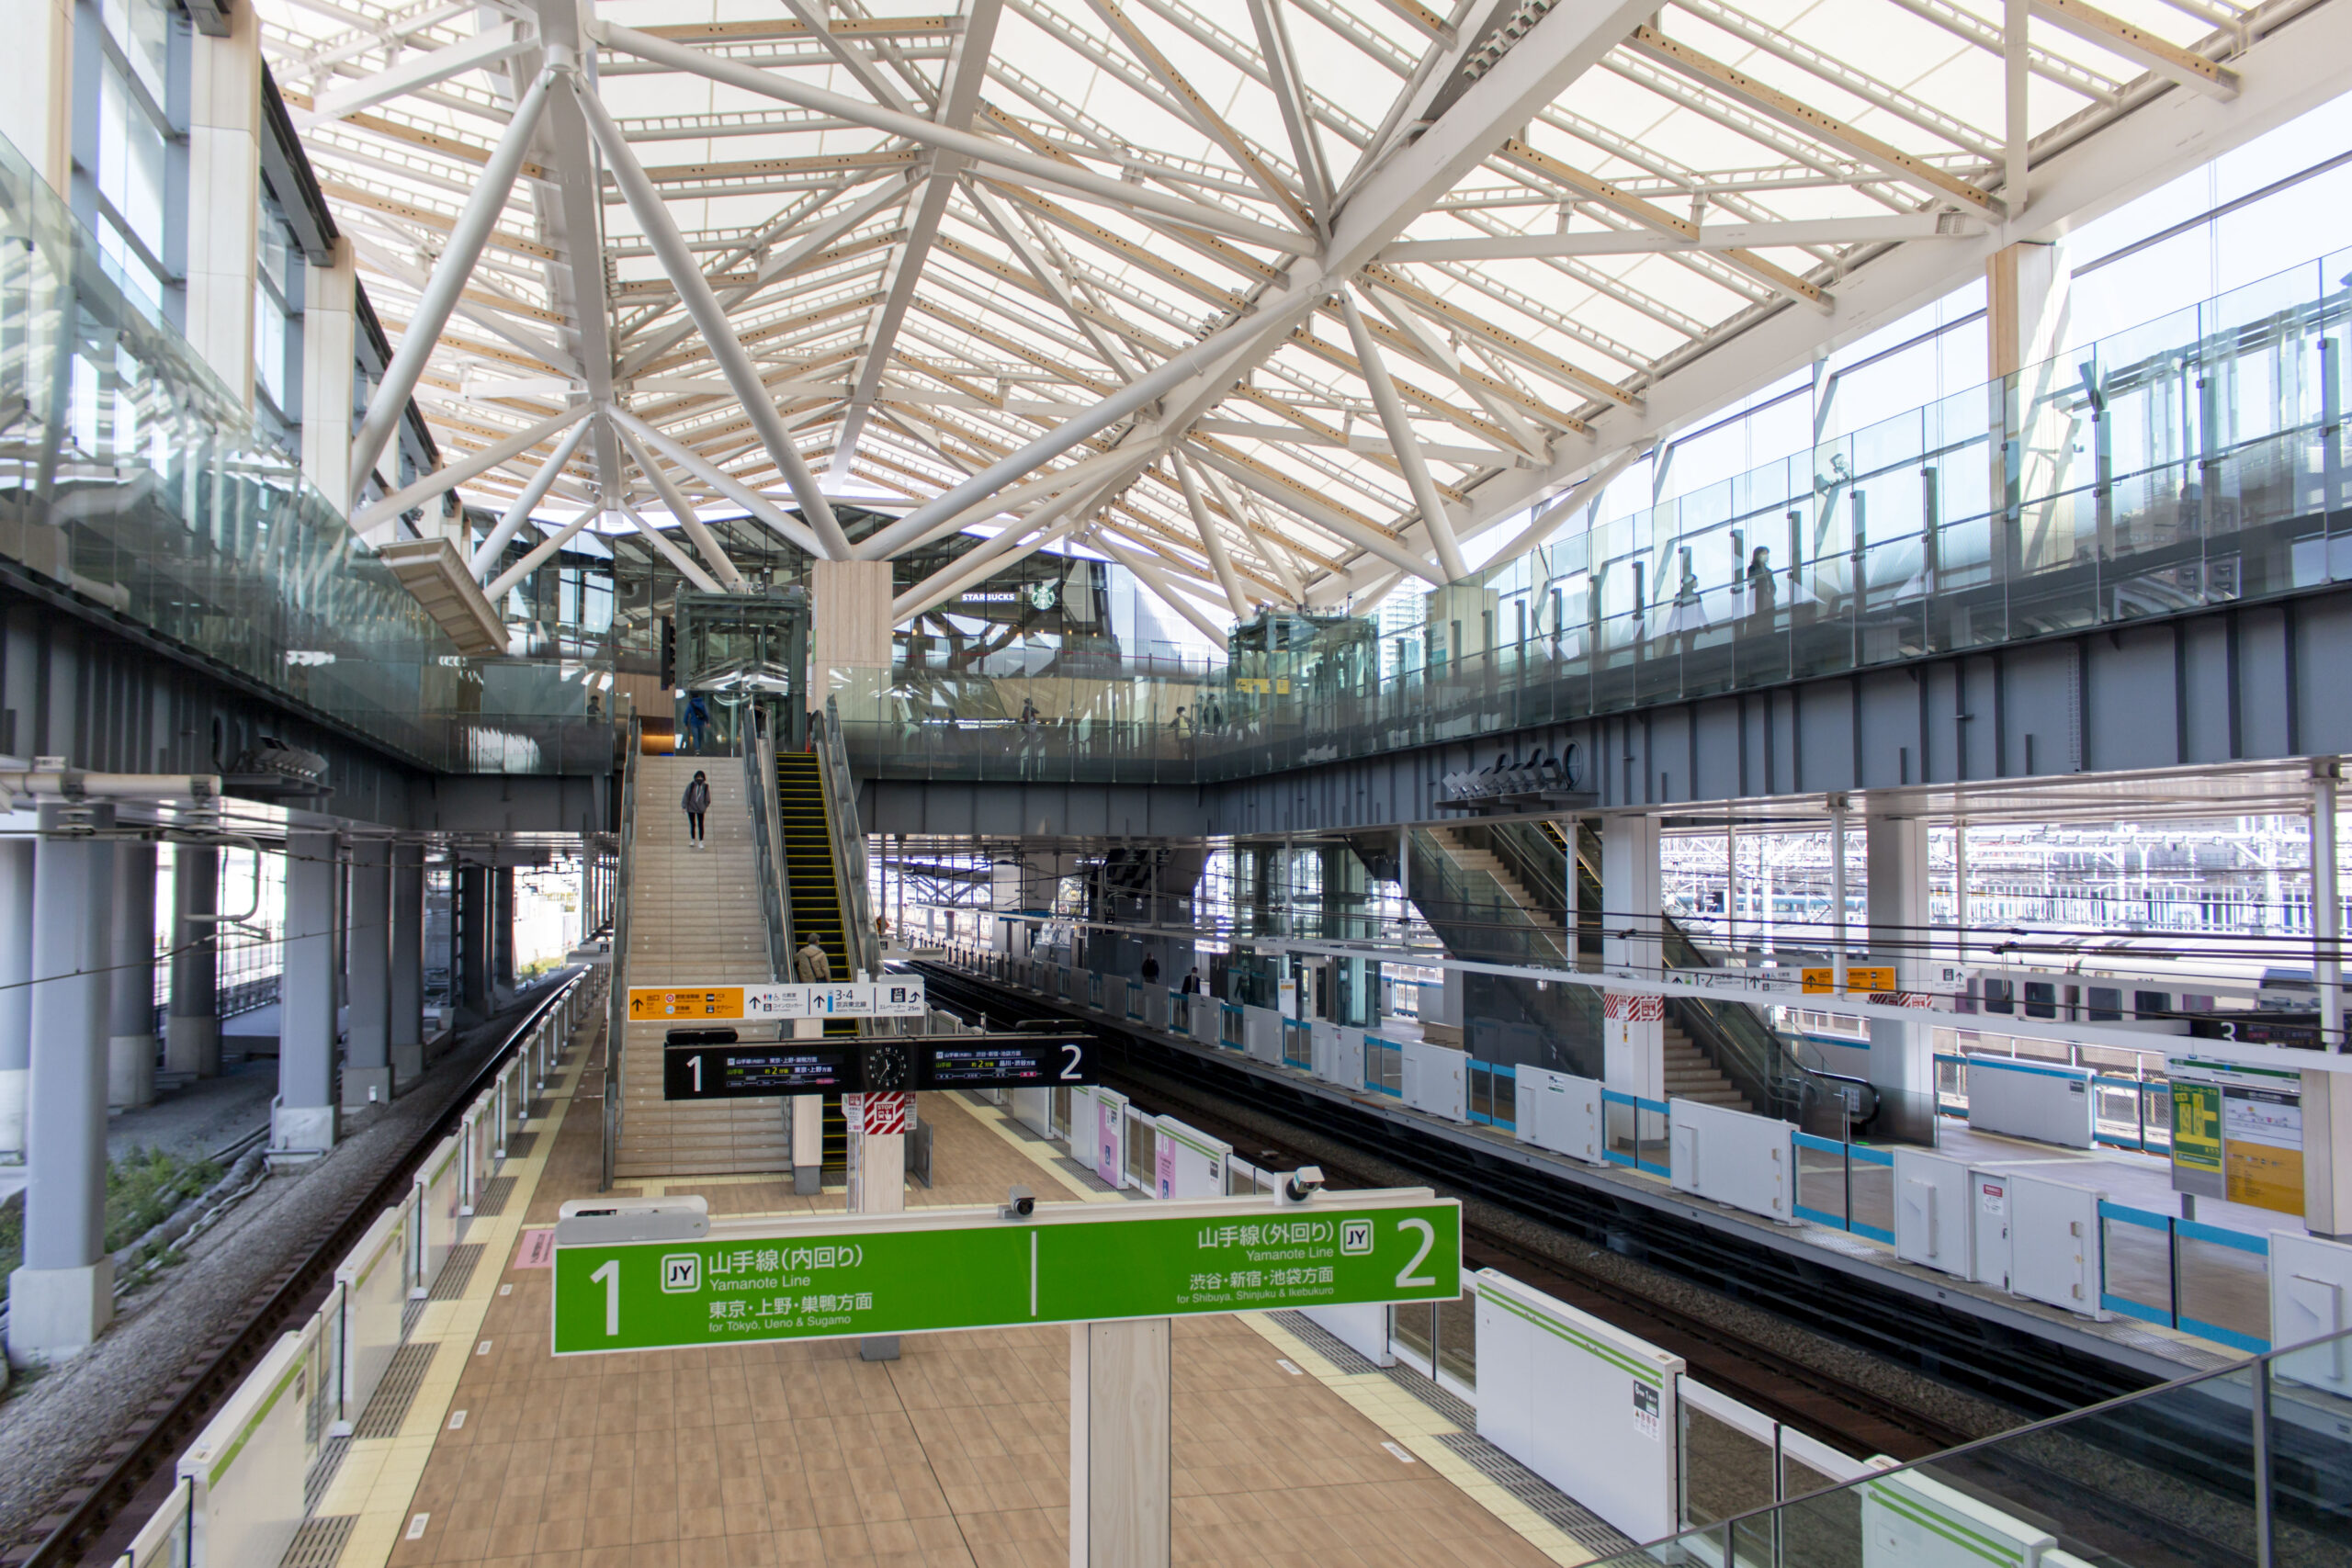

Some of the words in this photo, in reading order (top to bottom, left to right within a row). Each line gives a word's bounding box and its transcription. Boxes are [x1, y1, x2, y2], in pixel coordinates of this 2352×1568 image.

[2220, 1021, 2237, 1042] 3
[1059, 1044, 1083, 1079] 2
[685, 1055, 702, 1092] 1
[1198, 1221, 1334, 1249] 山手線(外回り)
[1347, 1229, 1366, 1246] JY
[708, 1244, 863, 1275] 山手線(内回り)
[1246, 1249, 1306, 1263] Yamanote
[1309, 1247, 1334, 1259] Line
[1395, 1218, 1436, 1288] 2
[670, 1265, 692, 1282] JY
[709, 1276, 778, 1292] Yamanote
[782, 1274, 810, 1288] Line
[589, 1259, 619, 1336] 1
[1177, 1293, 1189, 1303] for
[1193, 1292, 1233, 1304] Shibuya,
[1237, 1290, 1277, 1303] Shinjuku
[1279, 1288, 1286, 1298] &
[1289, 1286, 1334, 1298] Ikebukuro
[708, 1322, 723, 1333] for
[764, 1317, 793, 1329] Ueno
[796, 1316, 804, 1326] &
[807, 1314, 851, 1328] Sugamo
